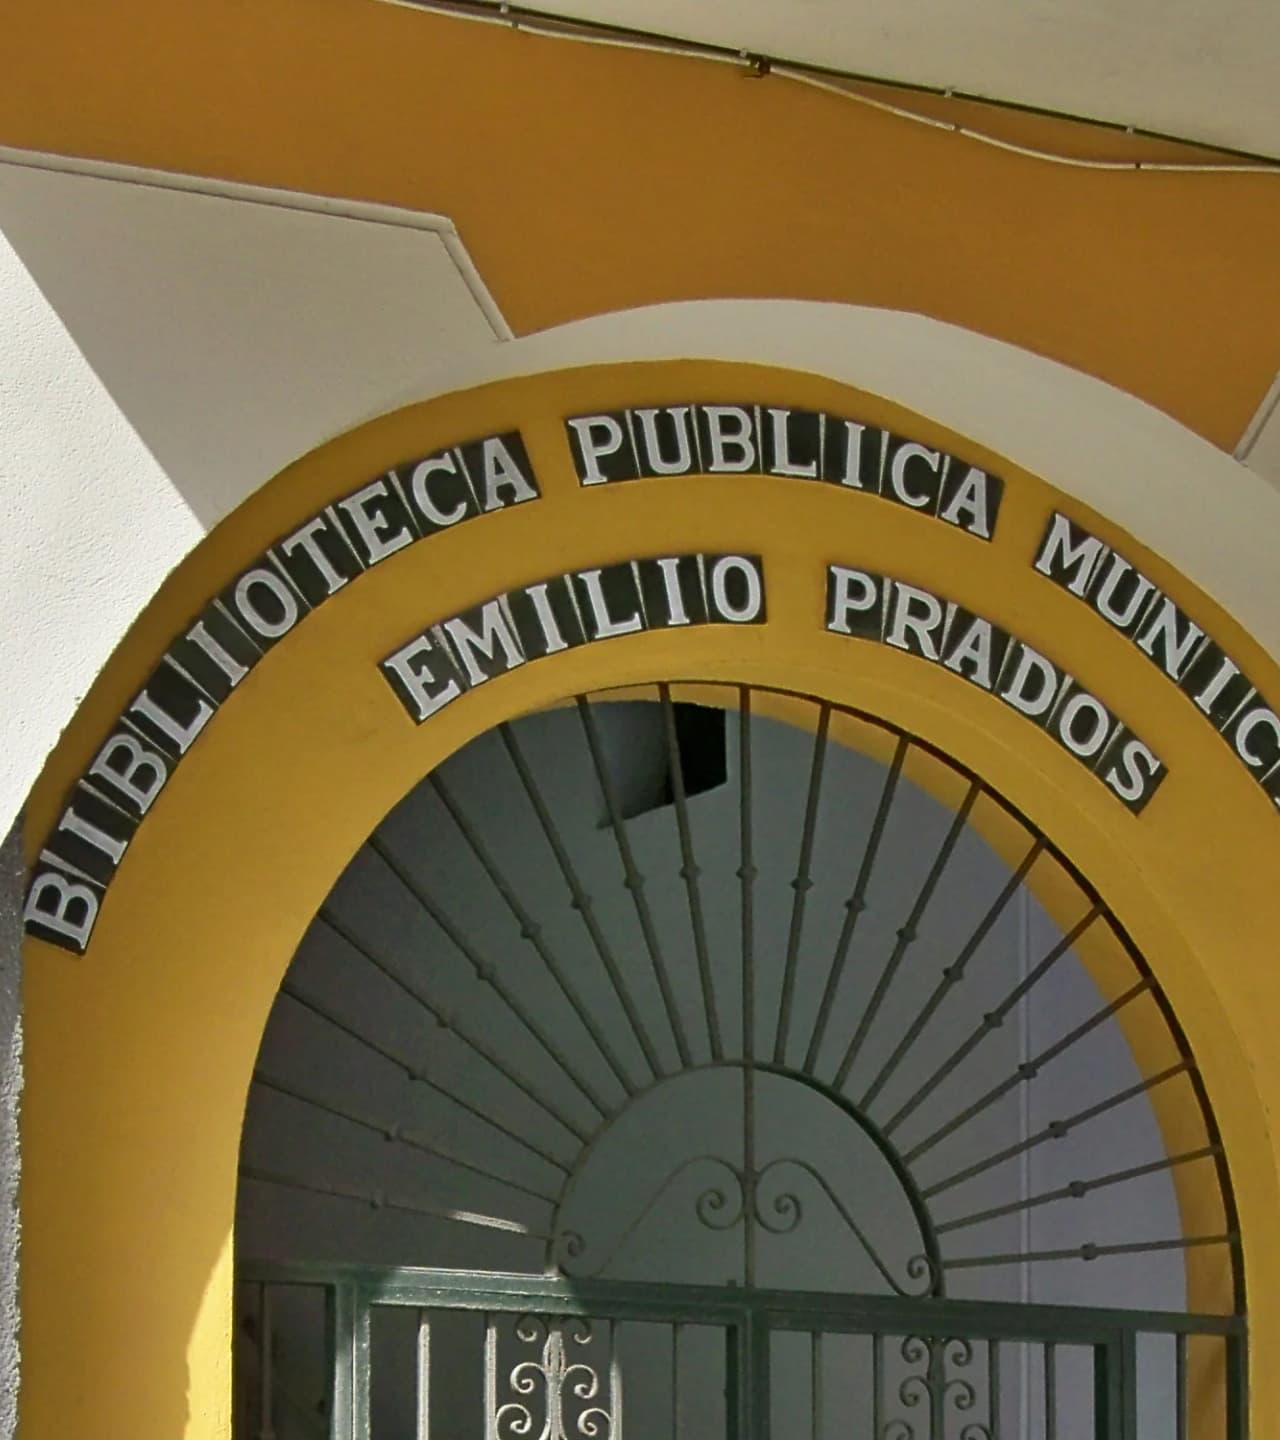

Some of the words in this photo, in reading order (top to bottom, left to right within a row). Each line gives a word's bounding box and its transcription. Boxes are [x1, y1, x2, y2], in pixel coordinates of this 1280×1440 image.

[24, 436, 538, 950] BIBLIOTECA
[567, 404, 992, 539] PUBLICA
[384, 555, 763, 721] EMILIO
[827, 564, 1161, 802] PRADOS
